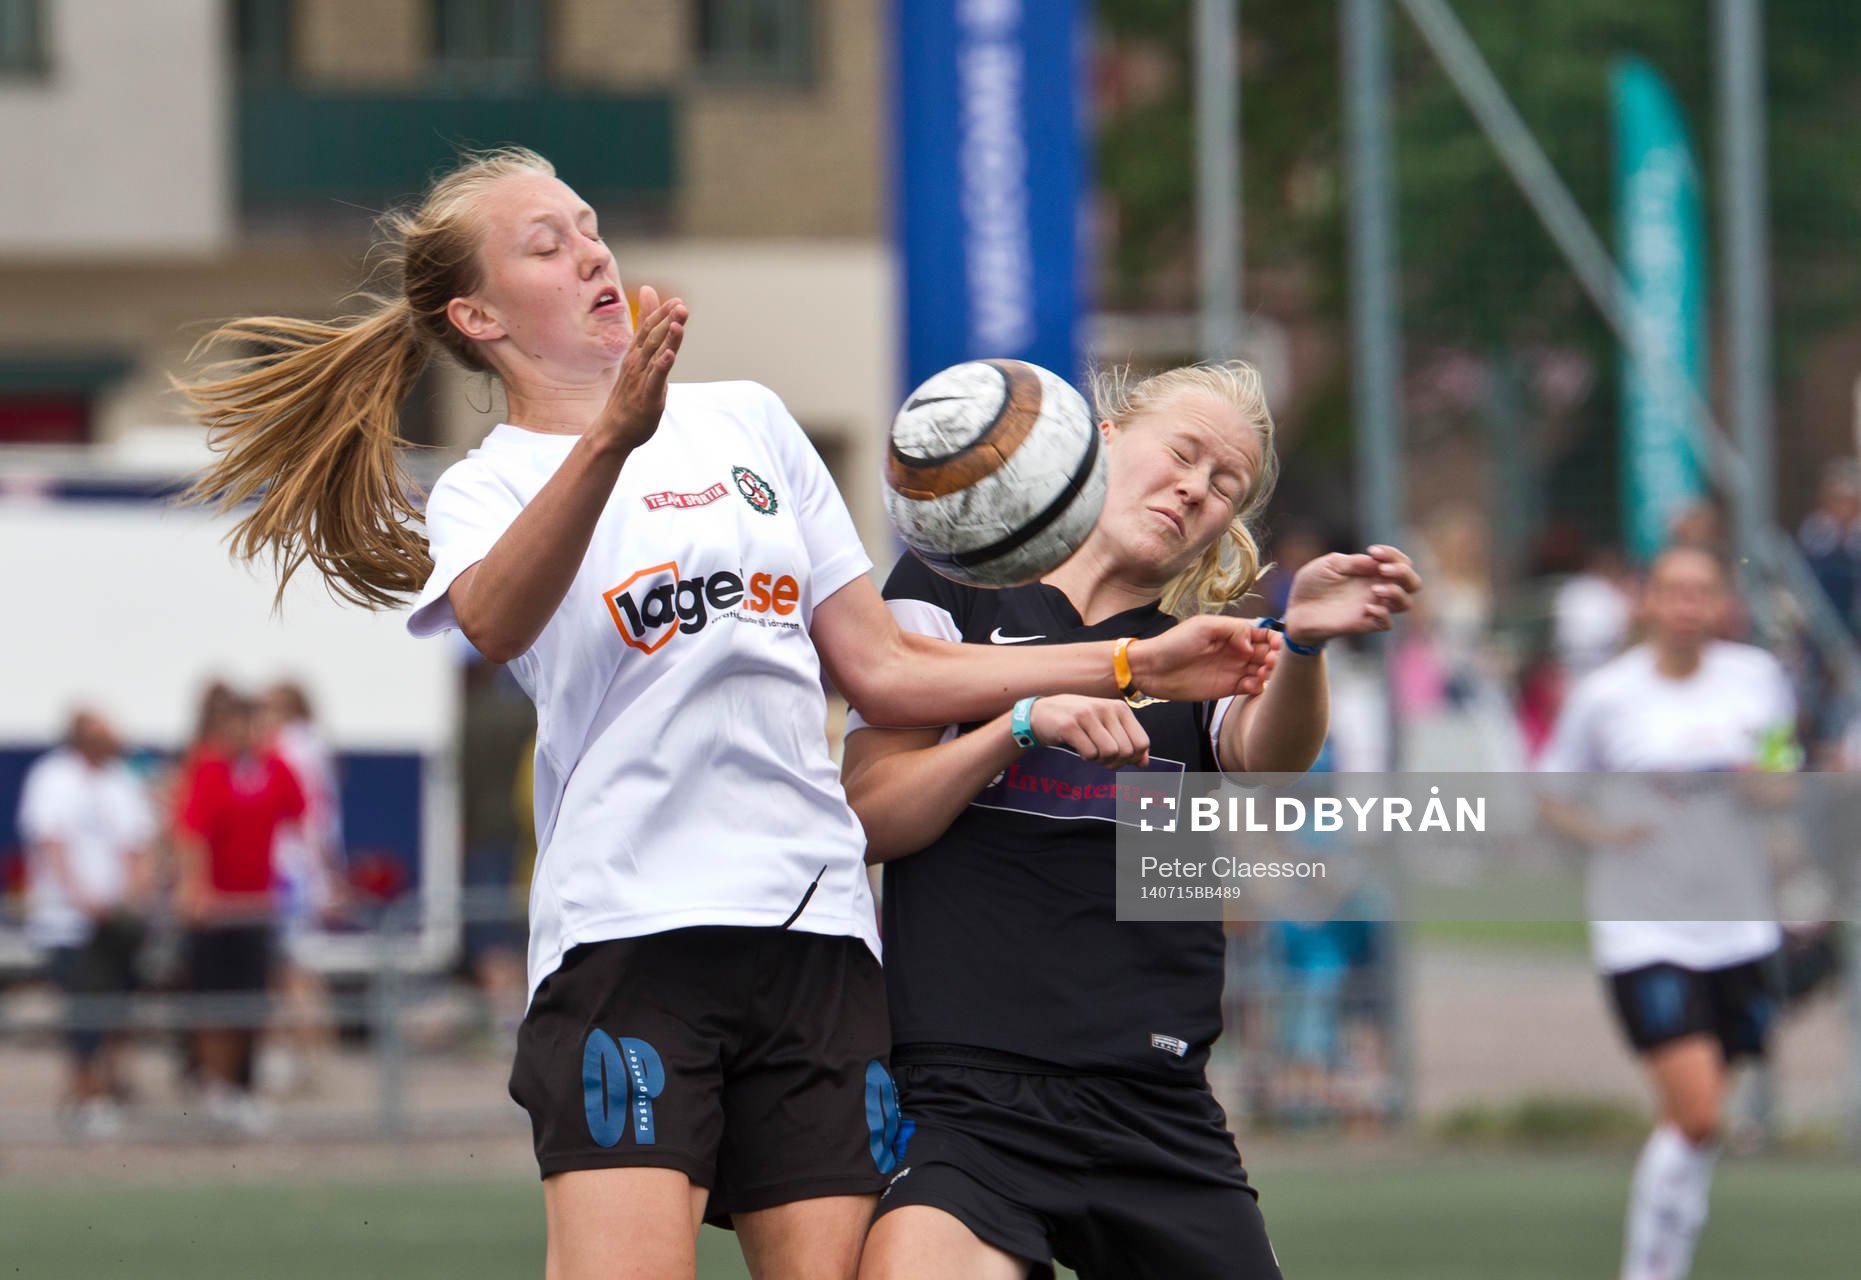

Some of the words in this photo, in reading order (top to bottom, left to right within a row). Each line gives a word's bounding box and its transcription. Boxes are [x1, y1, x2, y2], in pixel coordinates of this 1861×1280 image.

[646, 492, 684, 507] TEAM
[616, 568, 800, 635] lage.se
[582, 1027, 666, 1148] OP
[629, 1049, 649, 1131] Fastigheter
